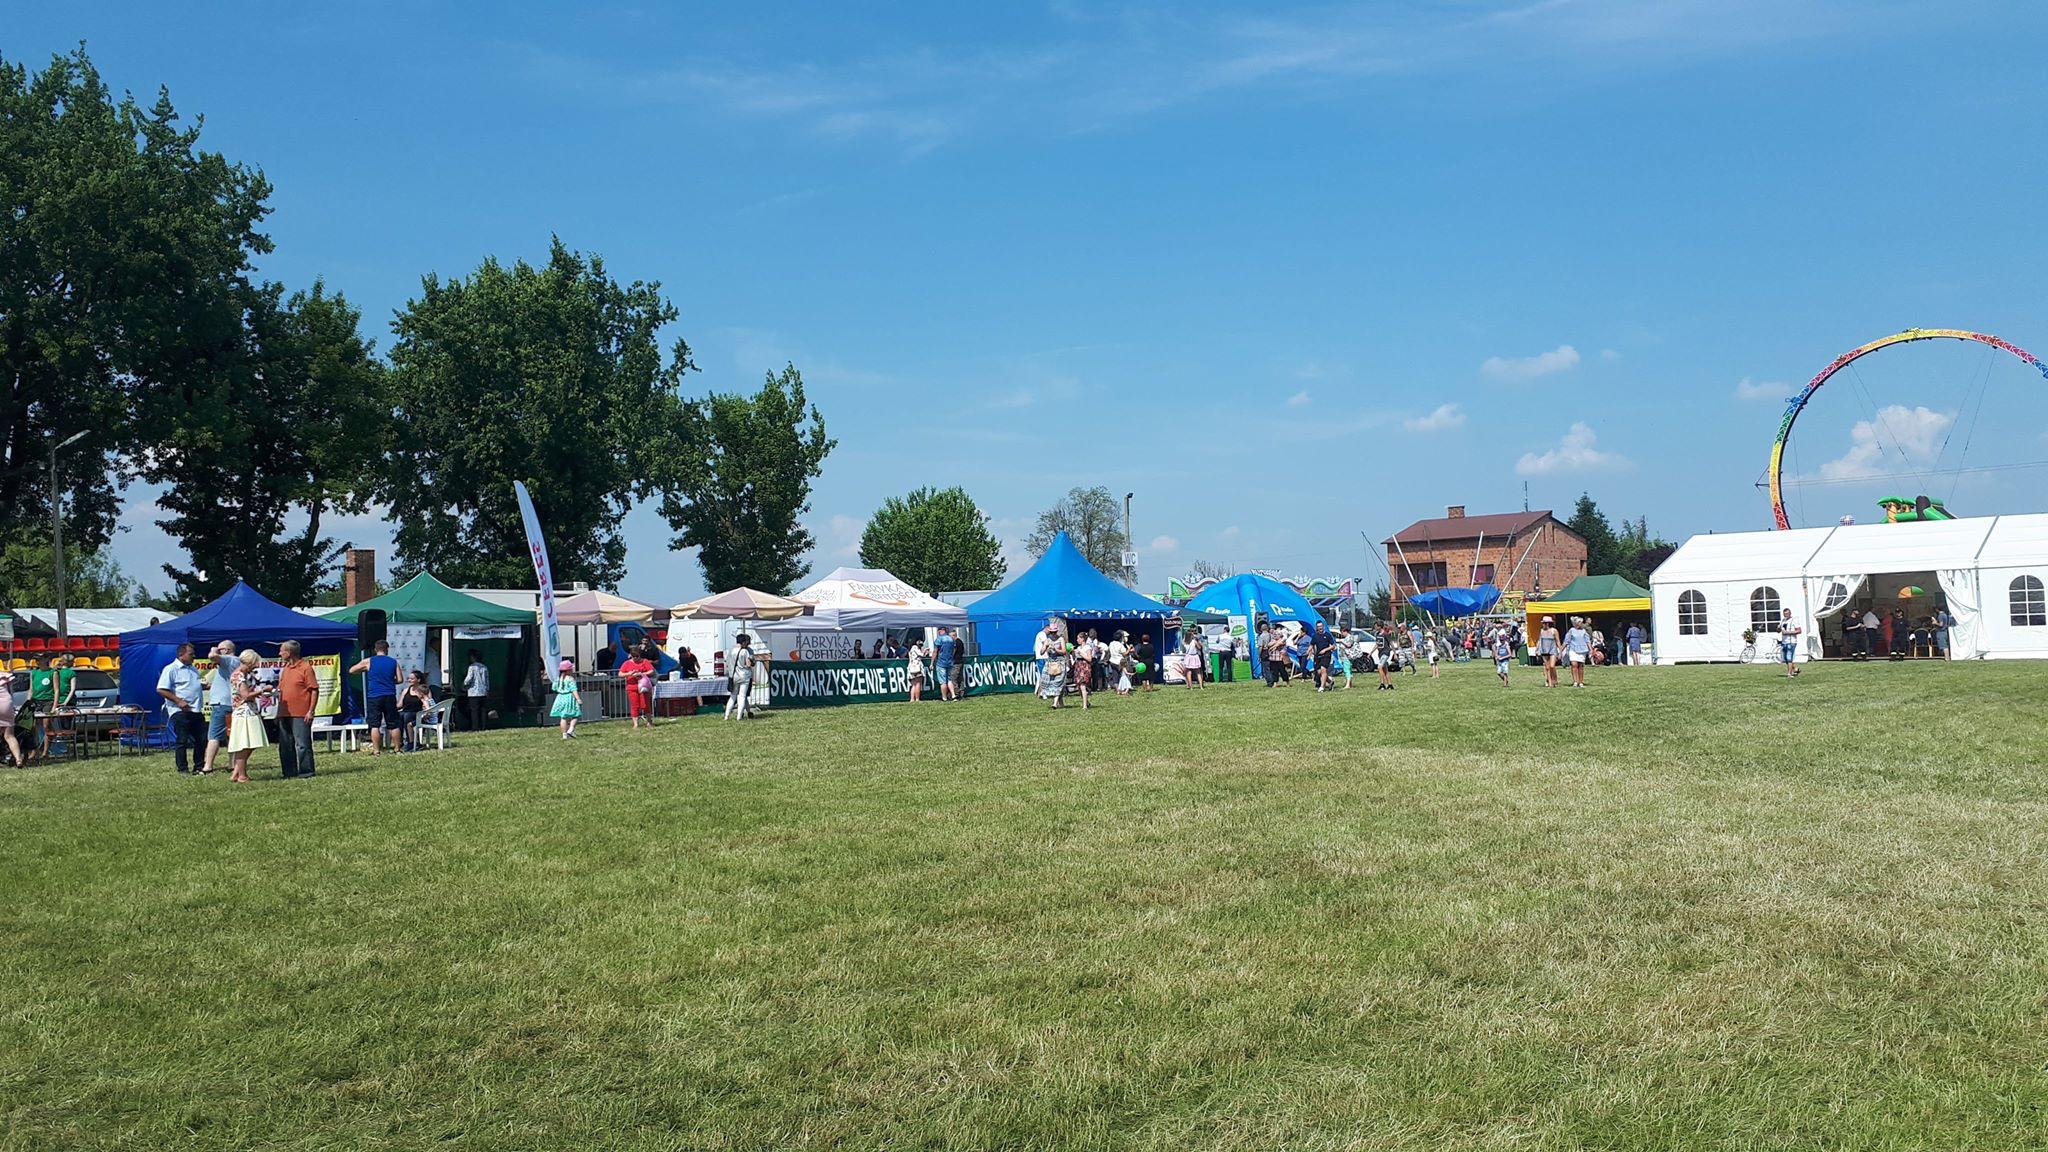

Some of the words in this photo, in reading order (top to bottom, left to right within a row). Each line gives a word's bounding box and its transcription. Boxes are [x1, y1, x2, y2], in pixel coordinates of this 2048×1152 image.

[1125, 552, 1136, 565] WC
[848, 582, 907, 595] FABRYKA
[796, 635, 853, 650] FABRYKA
[308, 658, 334, 666] DZIECI
[770, 668, 888, 698] STOWARZYSZENIE
